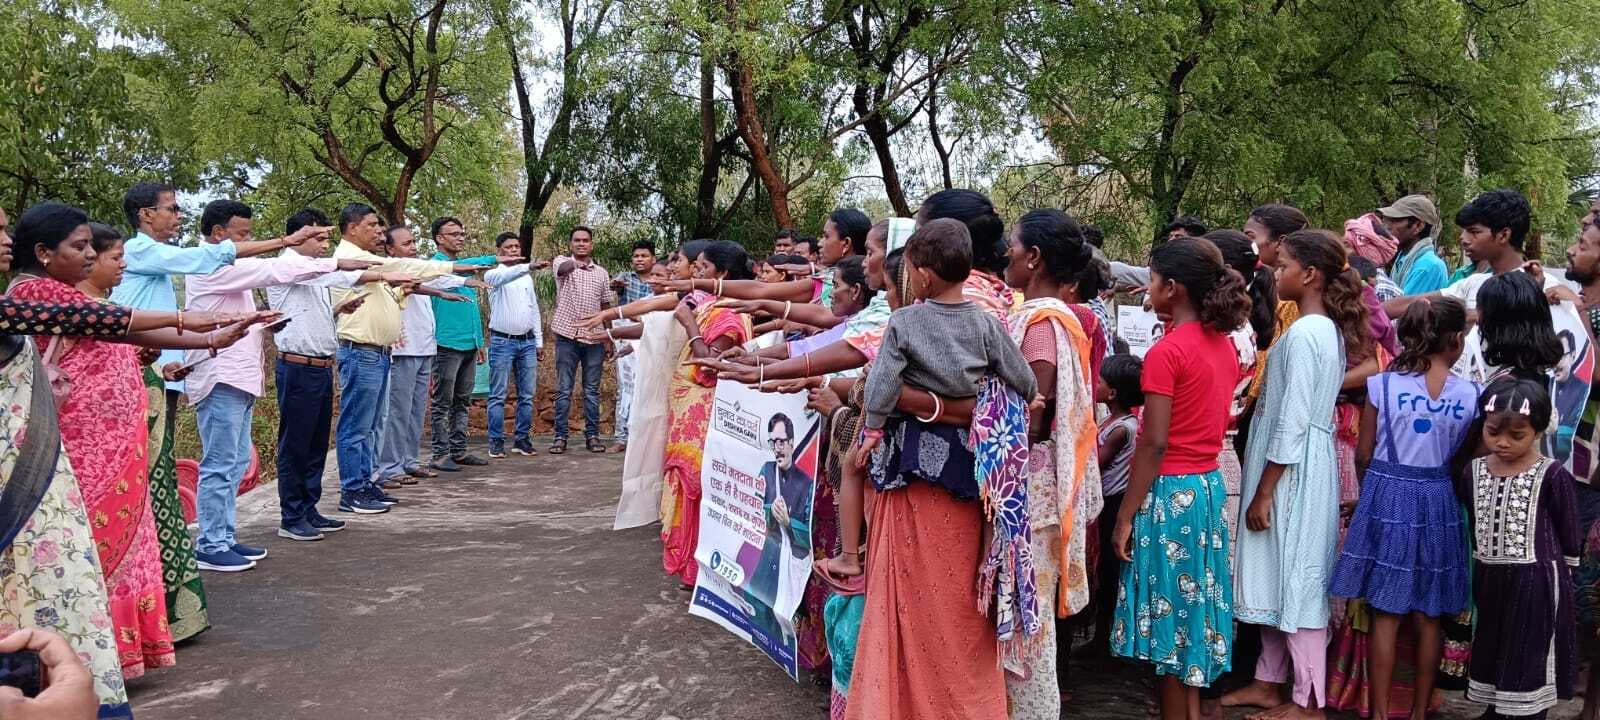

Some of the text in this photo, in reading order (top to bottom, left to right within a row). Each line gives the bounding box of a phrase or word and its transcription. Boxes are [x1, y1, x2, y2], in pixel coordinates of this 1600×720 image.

[1398, 392, 1464, 420] Fruit
[710, 477, 722, 491] एक
[724, 480, 731, 496] ही
[733, 484, 738, 499] है
[728, 466, 754, 488] मतदाता
[719, 564, 738, 580] 1950
